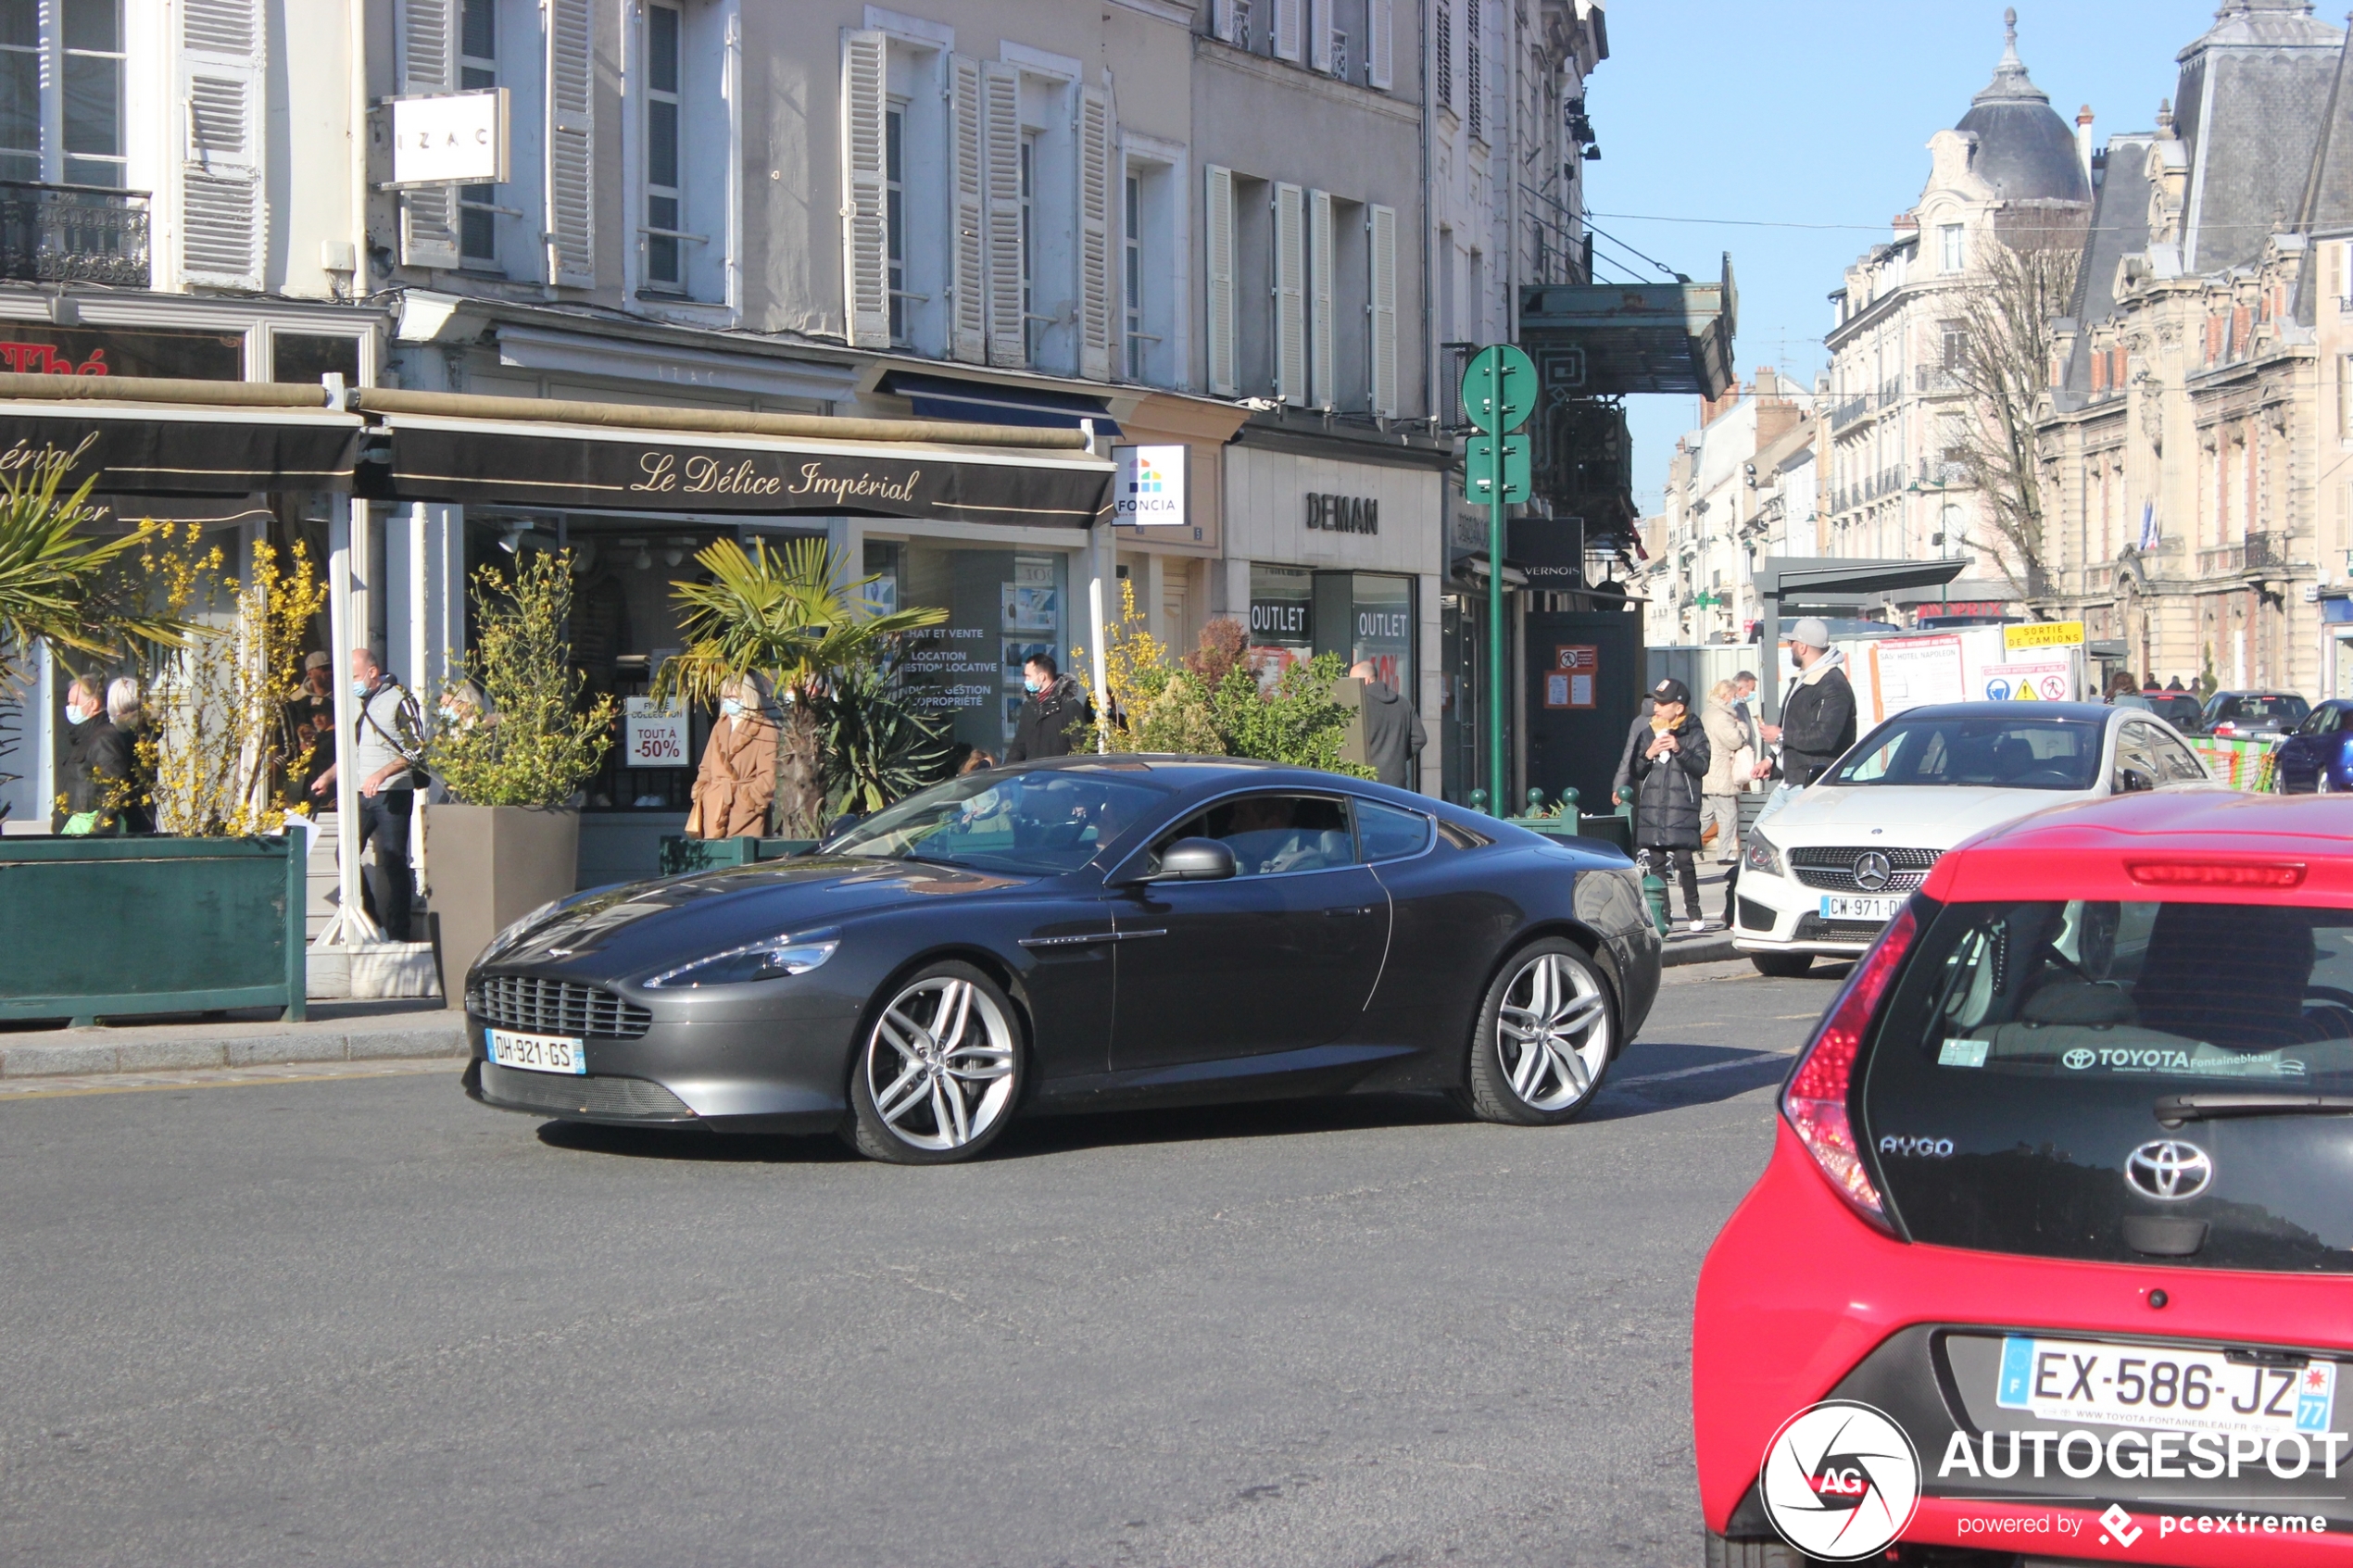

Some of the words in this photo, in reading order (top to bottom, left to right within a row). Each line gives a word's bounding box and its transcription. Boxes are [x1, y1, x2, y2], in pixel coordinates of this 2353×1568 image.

[397, 129, 487, 150] IZAC
[0, 431, 99, 470] érial
[630, 452, 675, 493] Le
[683, 456, 781, 495] Délice
[788, 462, 920, 505] Impérial
[1118, 499, 1176, 511] FONCIA
[1307, 492, 1378, 535] DEMAN
[1525, 566, 1580, 576] VERNOIS
[1252, 605, 1305, 632] OUTLET
[1359, 612, 1407, 637] OUTLET
[934, 629, 945, 638] ET
[949, 629, 984, 638] VENTE
[2008, 638, 2022, 646] DE
[2029, 633, 2080, 646] CAMIONS
[2023, 625, 2063, 636] SORTIE
[1906, 639, 1931, 647] INTERDIT
[912, 651, 966, 660] LOCATION
[1897, 652, 1919, 660] HOTEL
[1920, 649, 1956, 659] NAPOLEON
[946, 662, 997, 672] LOCATIVE
[637, 728, 666, 739] TOUT
[669, 726, 677, 739] À
[635, 739, 680, 758] -50%
[1831, 898, 1903, 917] CW-971-D
[496, 1035, 571, 1067] DH-921-GS
[2098, 1048, 2190, 1068] TOYOTA
[2190, 1053, 2271, 1068] Fontainebleau
[1879, 1135, 1955, 1158] AYGO
[2008, 1378, 2020, 1394] F
[2034, 1351, 2297, 1418] EX-586-JZ
[2076, 1409, 2248, 1432] WWW.TOYOTA-FONTAINEBLEAU.FR
[2299, 1399, 2325, 1426] 77
